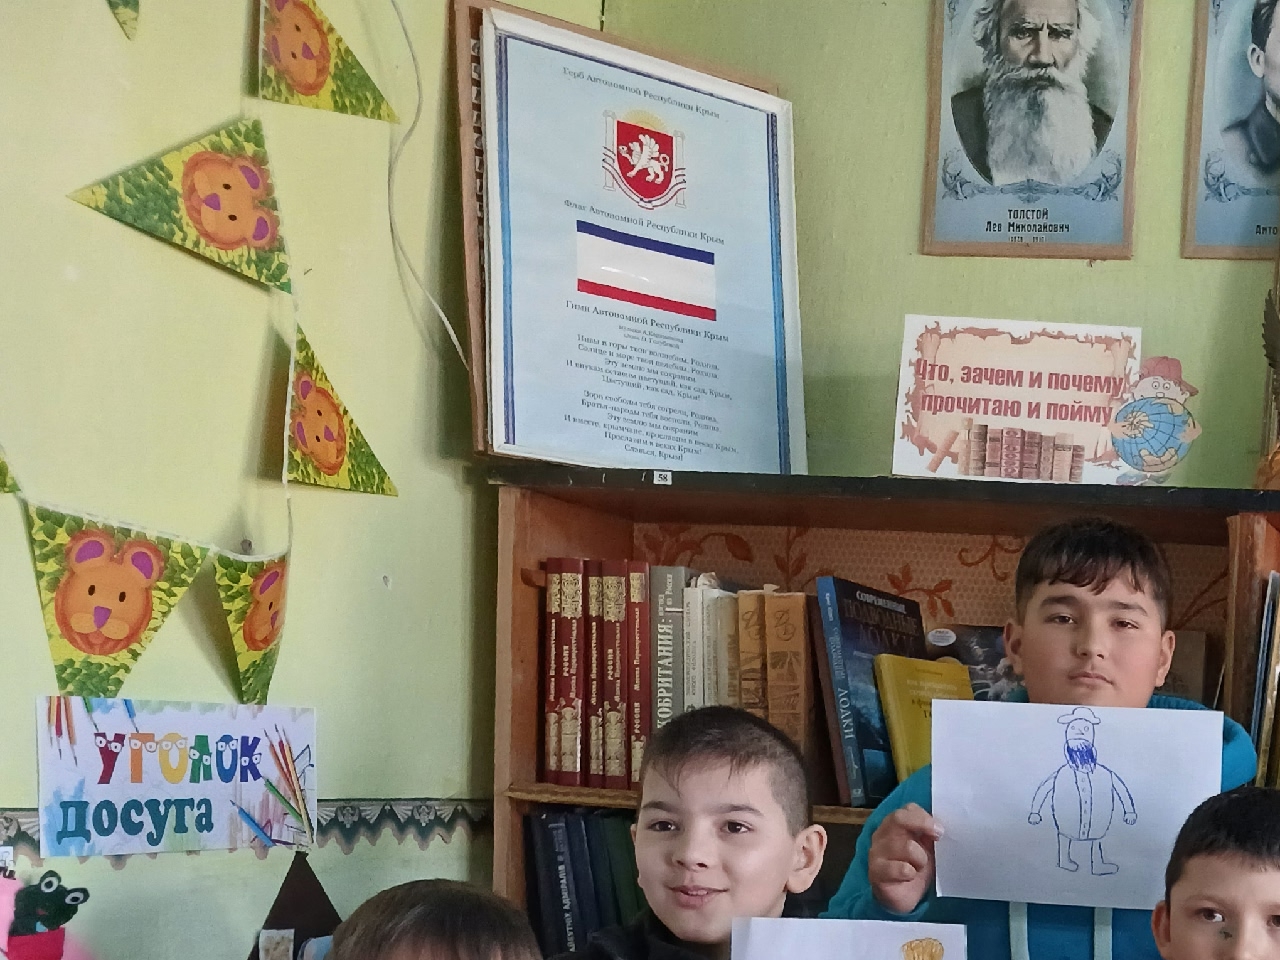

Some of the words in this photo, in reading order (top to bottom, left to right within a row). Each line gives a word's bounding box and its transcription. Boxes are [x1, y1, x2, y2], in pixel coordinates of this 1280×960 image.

[589, 205, 644, 226] Автономной
[646, 220, 698, 239] Республики
[700, 232, 725, 246] Крым
[986, 221, 1002, 232] Лев
[1008, 208, 1049, 219] ТОЛСТОЙ
[566, 300, 590, 313] Гимн
[592, 307, 648, 326] Автономной
[650, 318, 701, 337] Республики
[704, 330, 729, 342] Крым
[915, 358, 954, 384] Что,
[960, 365, 1023, 388] зачем
[1028, 371, 1042, 388] и
[1047, 372, 1124, 398] почему
[921, 394, 1021, 417] прочитаю
[1027, 403, 1041, 420] и
[1046, 400, 1113, 427] пойму
[657, 473, 668, 482] 58
[837, 687, 856, 739] ЛОДКИ
[94, 732, 262, 784] УГОЛОК
[56, 797, 214, 846] досуга
